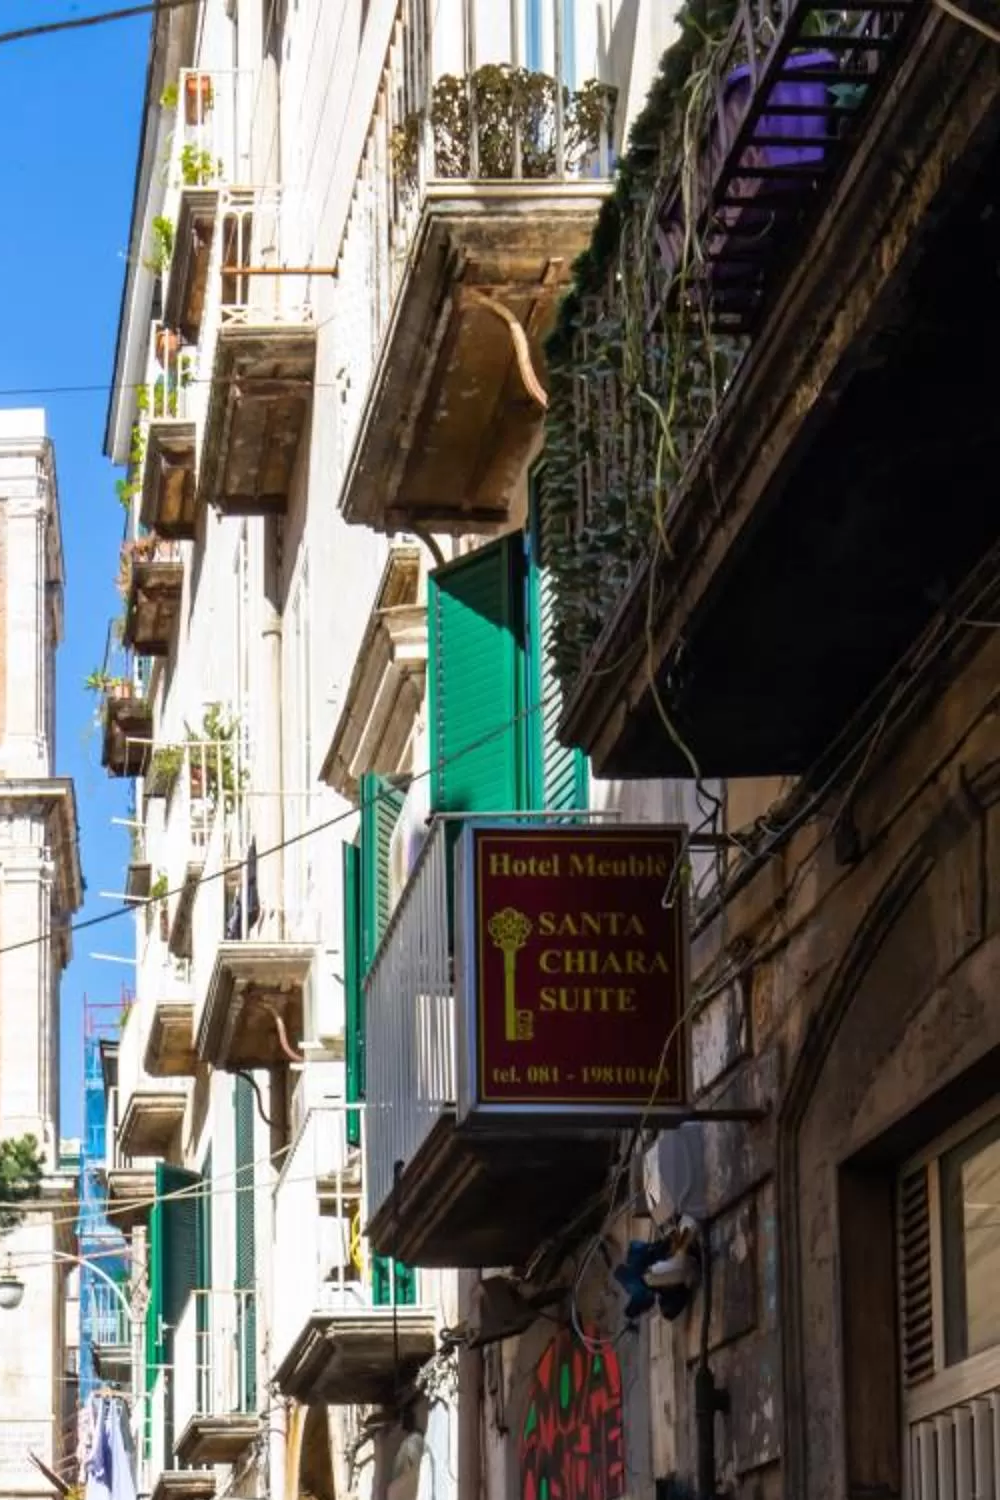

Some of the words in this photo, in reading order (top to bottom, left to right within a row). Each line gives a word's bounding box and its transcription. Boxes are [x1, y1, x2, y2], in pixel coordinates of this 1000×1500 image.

[489, 853, 559, 877] Hotel
[538, 911, 645, 936] SANTA
[538, 950, 669, 974] CHIARA
[538, 986, 637, 1012] SUITE
[492, 1065, 521, 1084] tel.
[527, 1065, 560, 1084] 081
